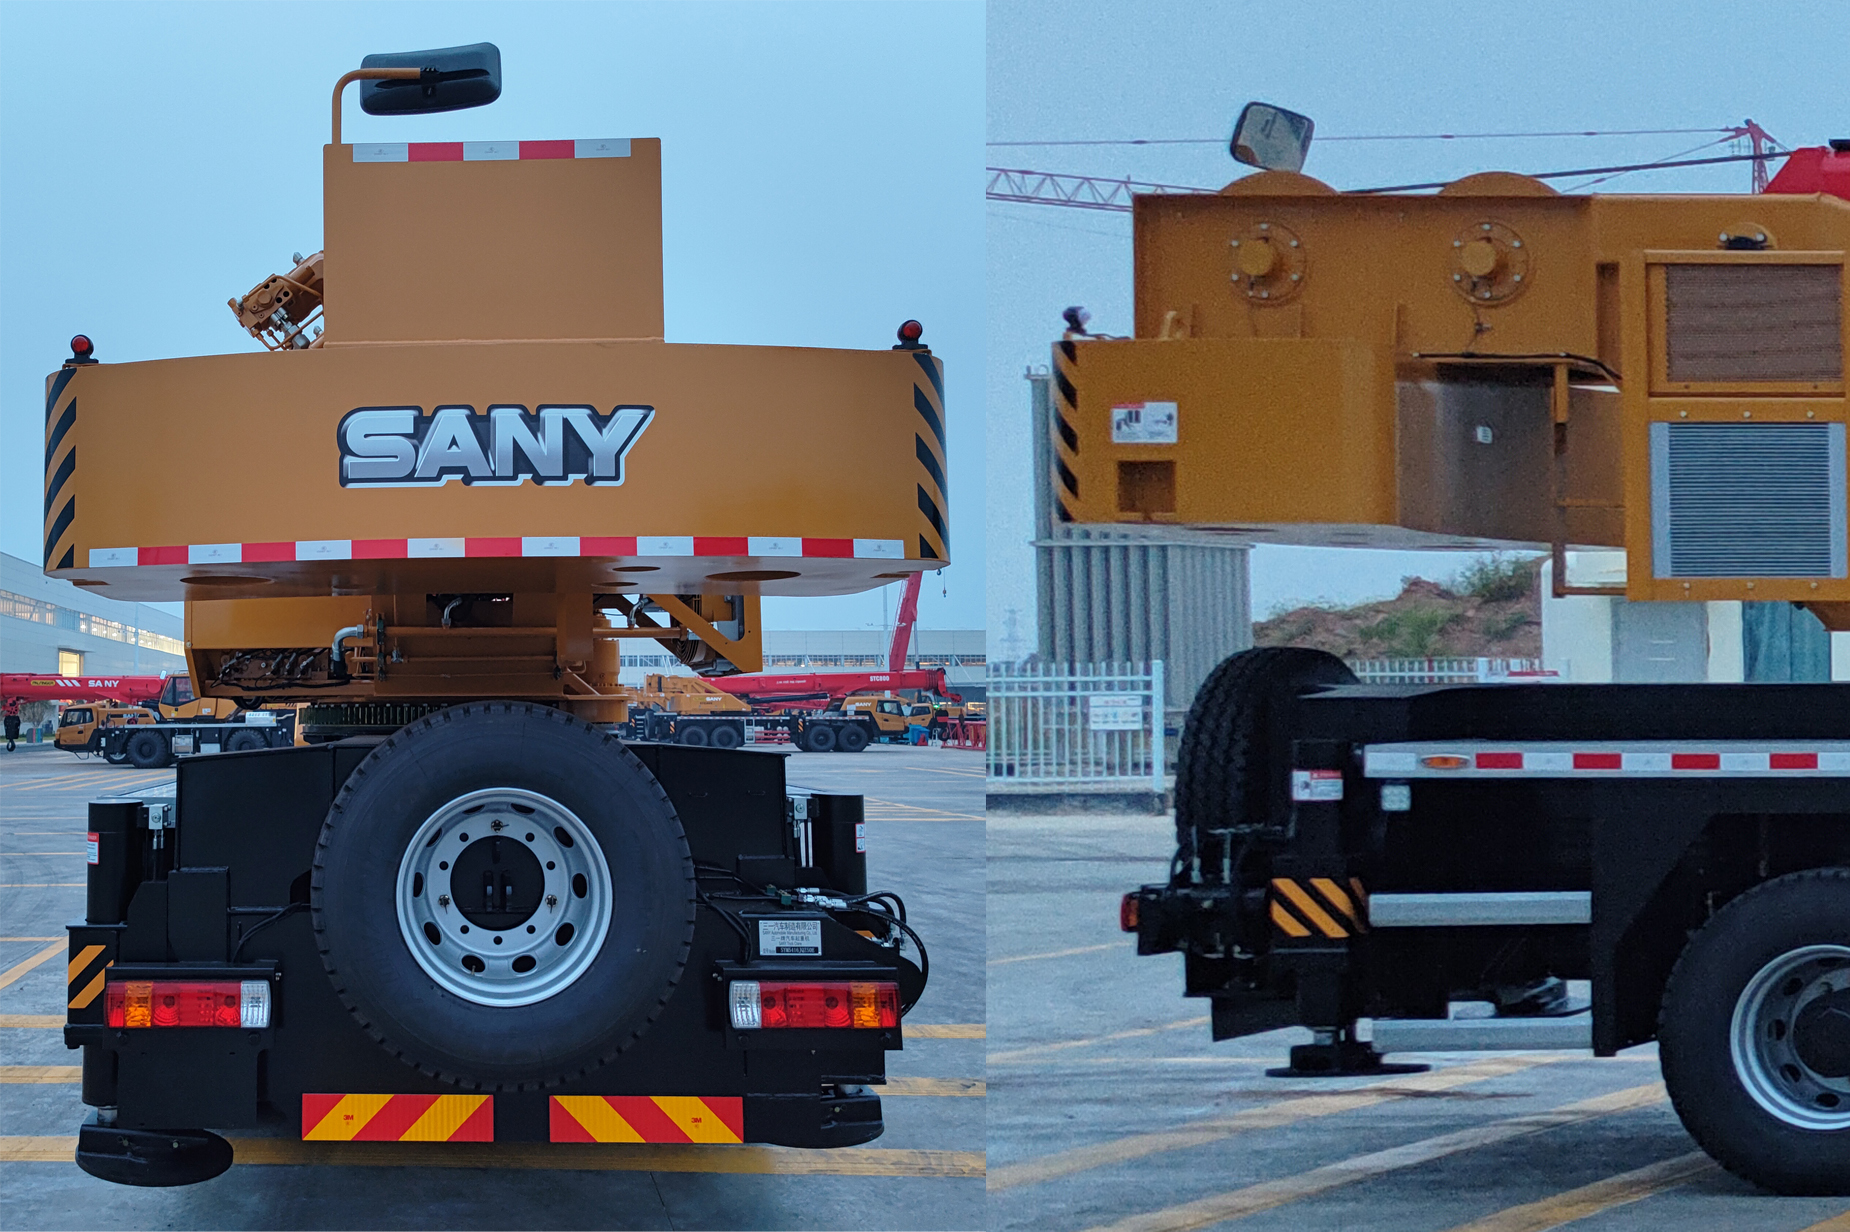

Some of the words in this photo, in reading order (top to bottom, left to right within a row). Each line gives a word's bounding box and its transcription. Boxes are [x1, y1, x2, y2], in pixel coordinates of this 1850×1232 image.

[337, 404, 655, 488] SANY
[88, 680, 120, 688] SANY
[763, 922, 818, 931] 三一汽车制造有限公司
